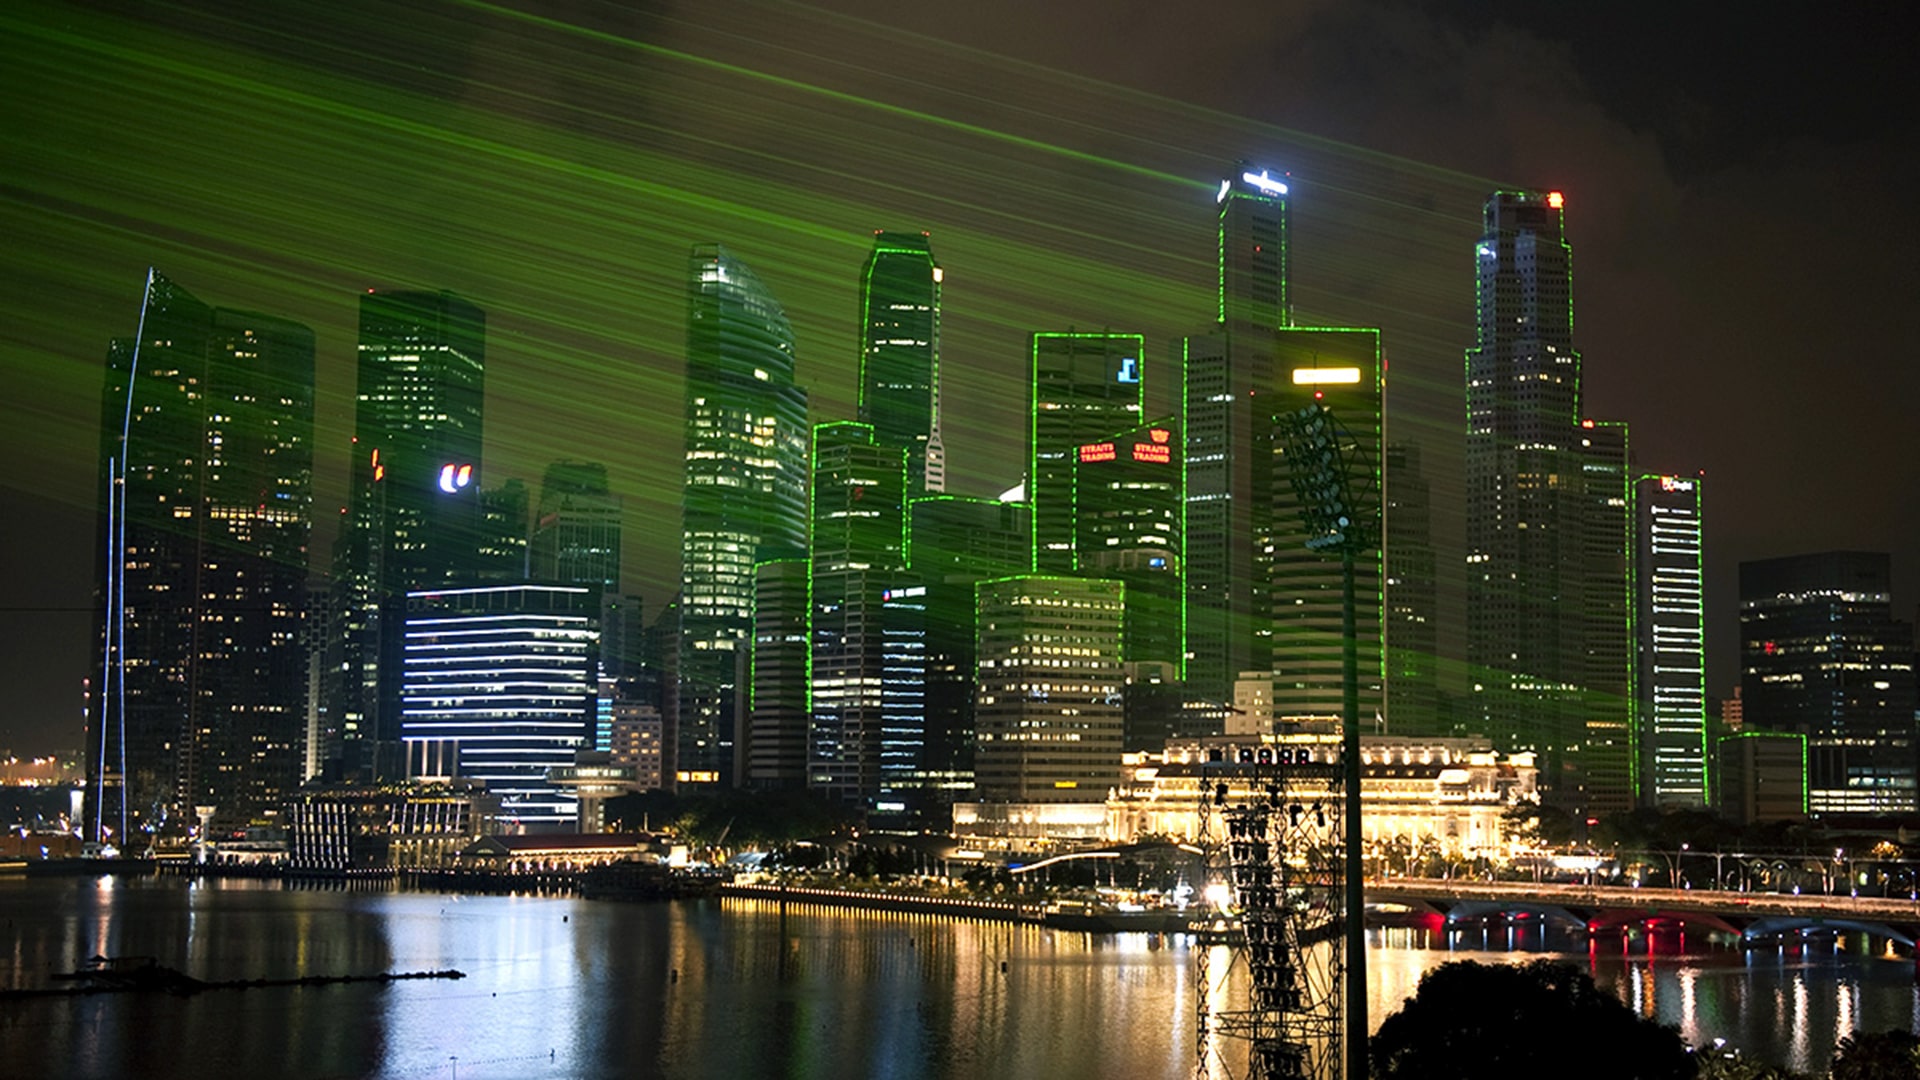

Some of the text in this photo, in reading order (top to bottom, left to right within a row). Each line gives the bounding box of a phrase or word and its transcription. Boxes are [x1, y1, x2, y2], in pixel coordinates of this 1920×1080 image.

[1080, 443, 1114, 453] STRAITS
[1134, 443, 1170, 454] STRAITS
[1080, 452, 1116, 462] TRADING
[1132, 452, 1170, 463] TRADING
